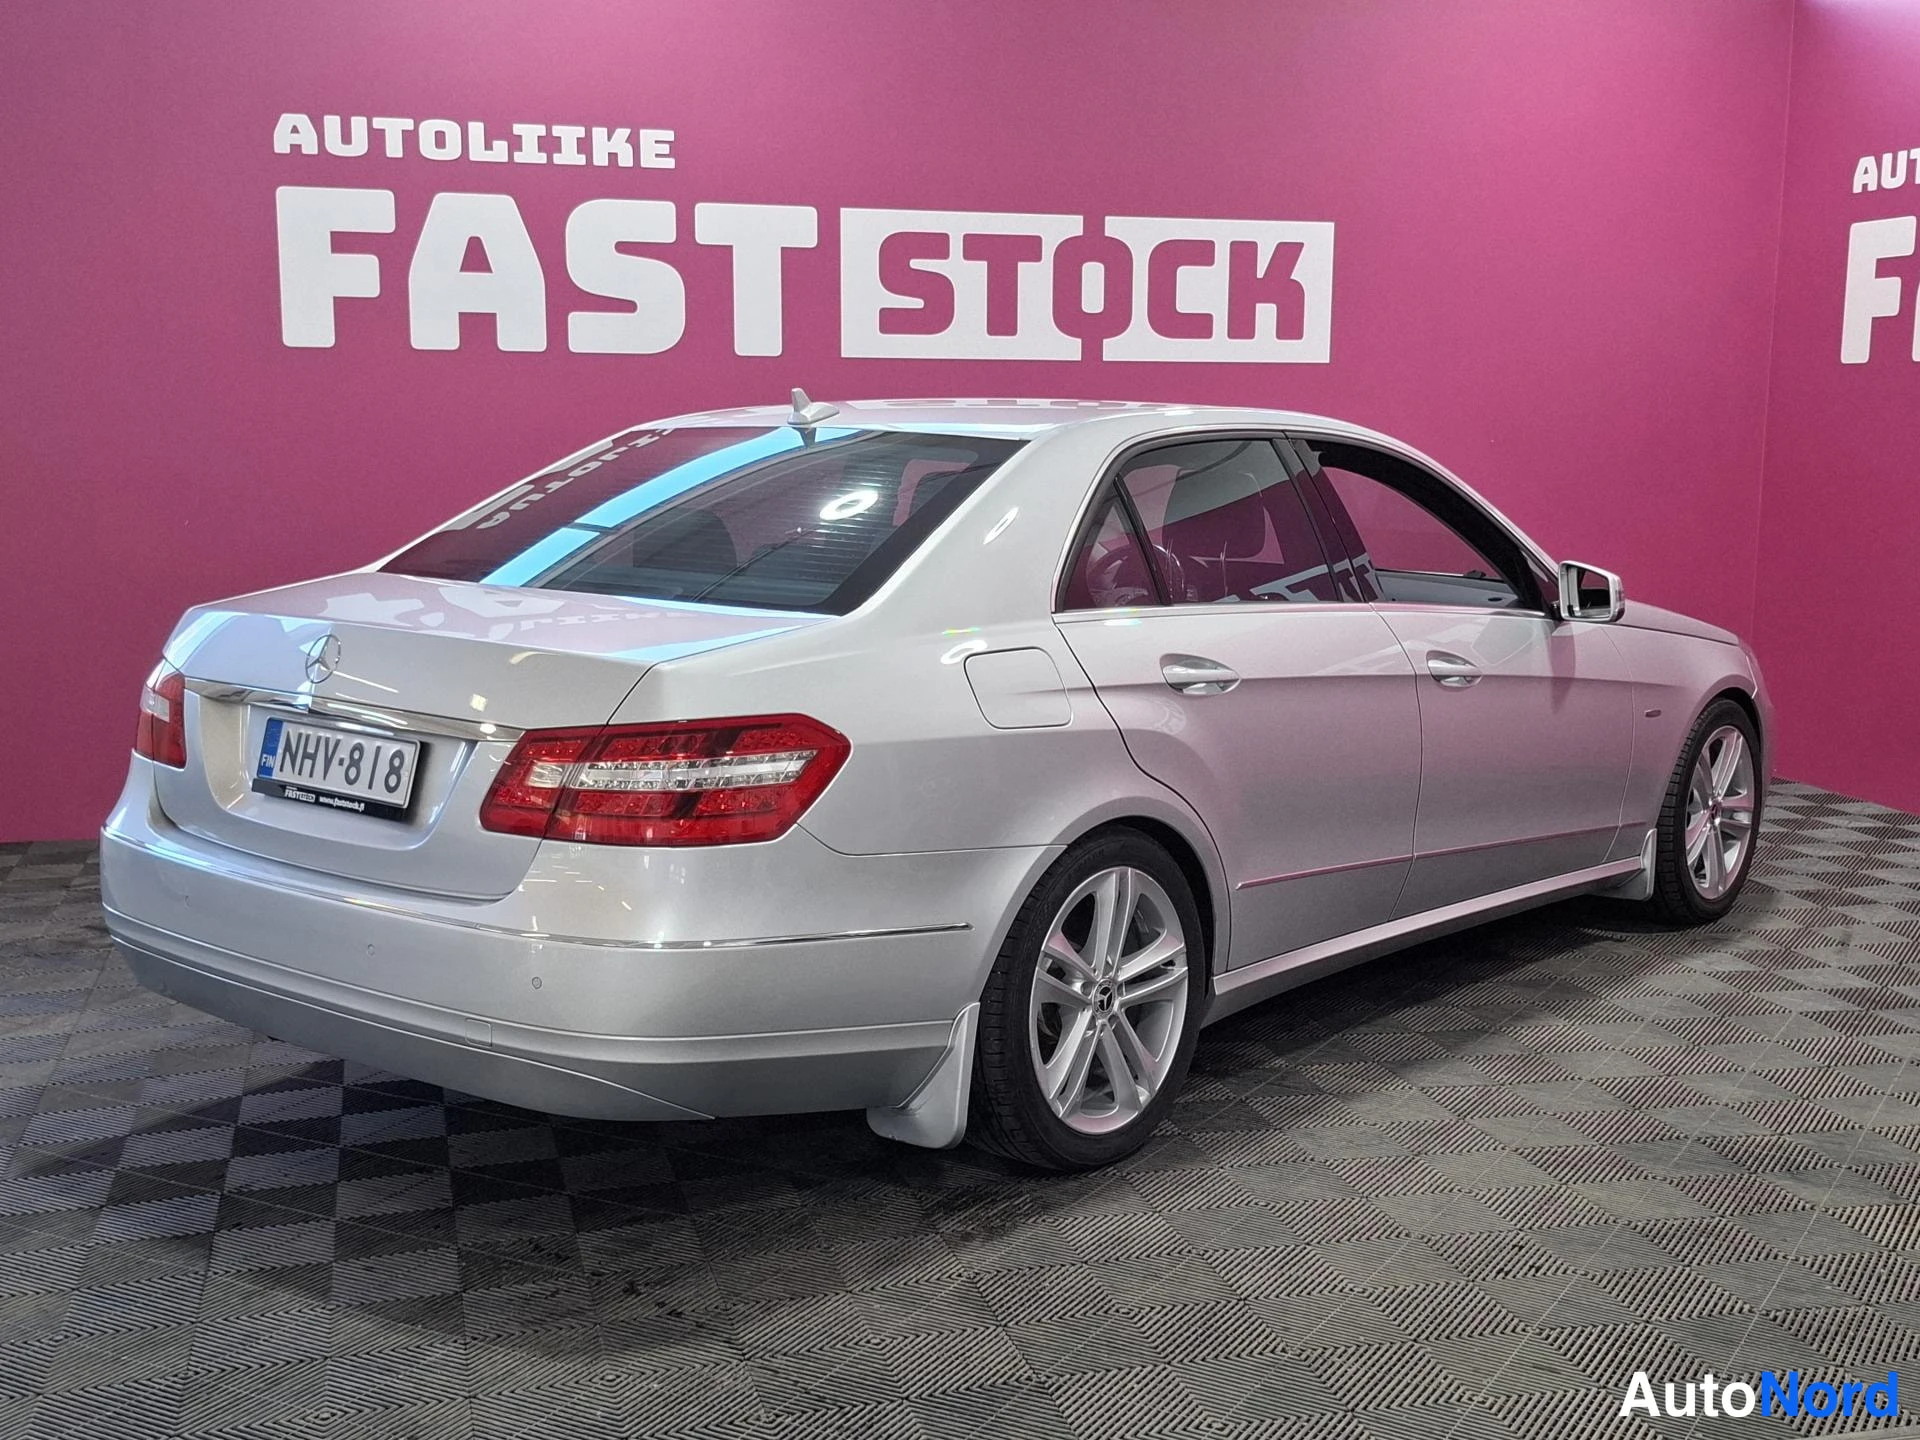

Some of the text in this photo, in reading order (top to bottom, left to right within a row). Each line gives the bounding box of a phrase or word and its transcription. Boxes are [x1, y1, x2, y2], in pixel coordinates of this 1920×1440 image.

[273, 112, 676, 170] AUTOLIIKE
[275, 185, 1306, 357] FAST STOCK
[261, 754, 276, 769] FIN
[279, 730, 405, 794] NHV-818
